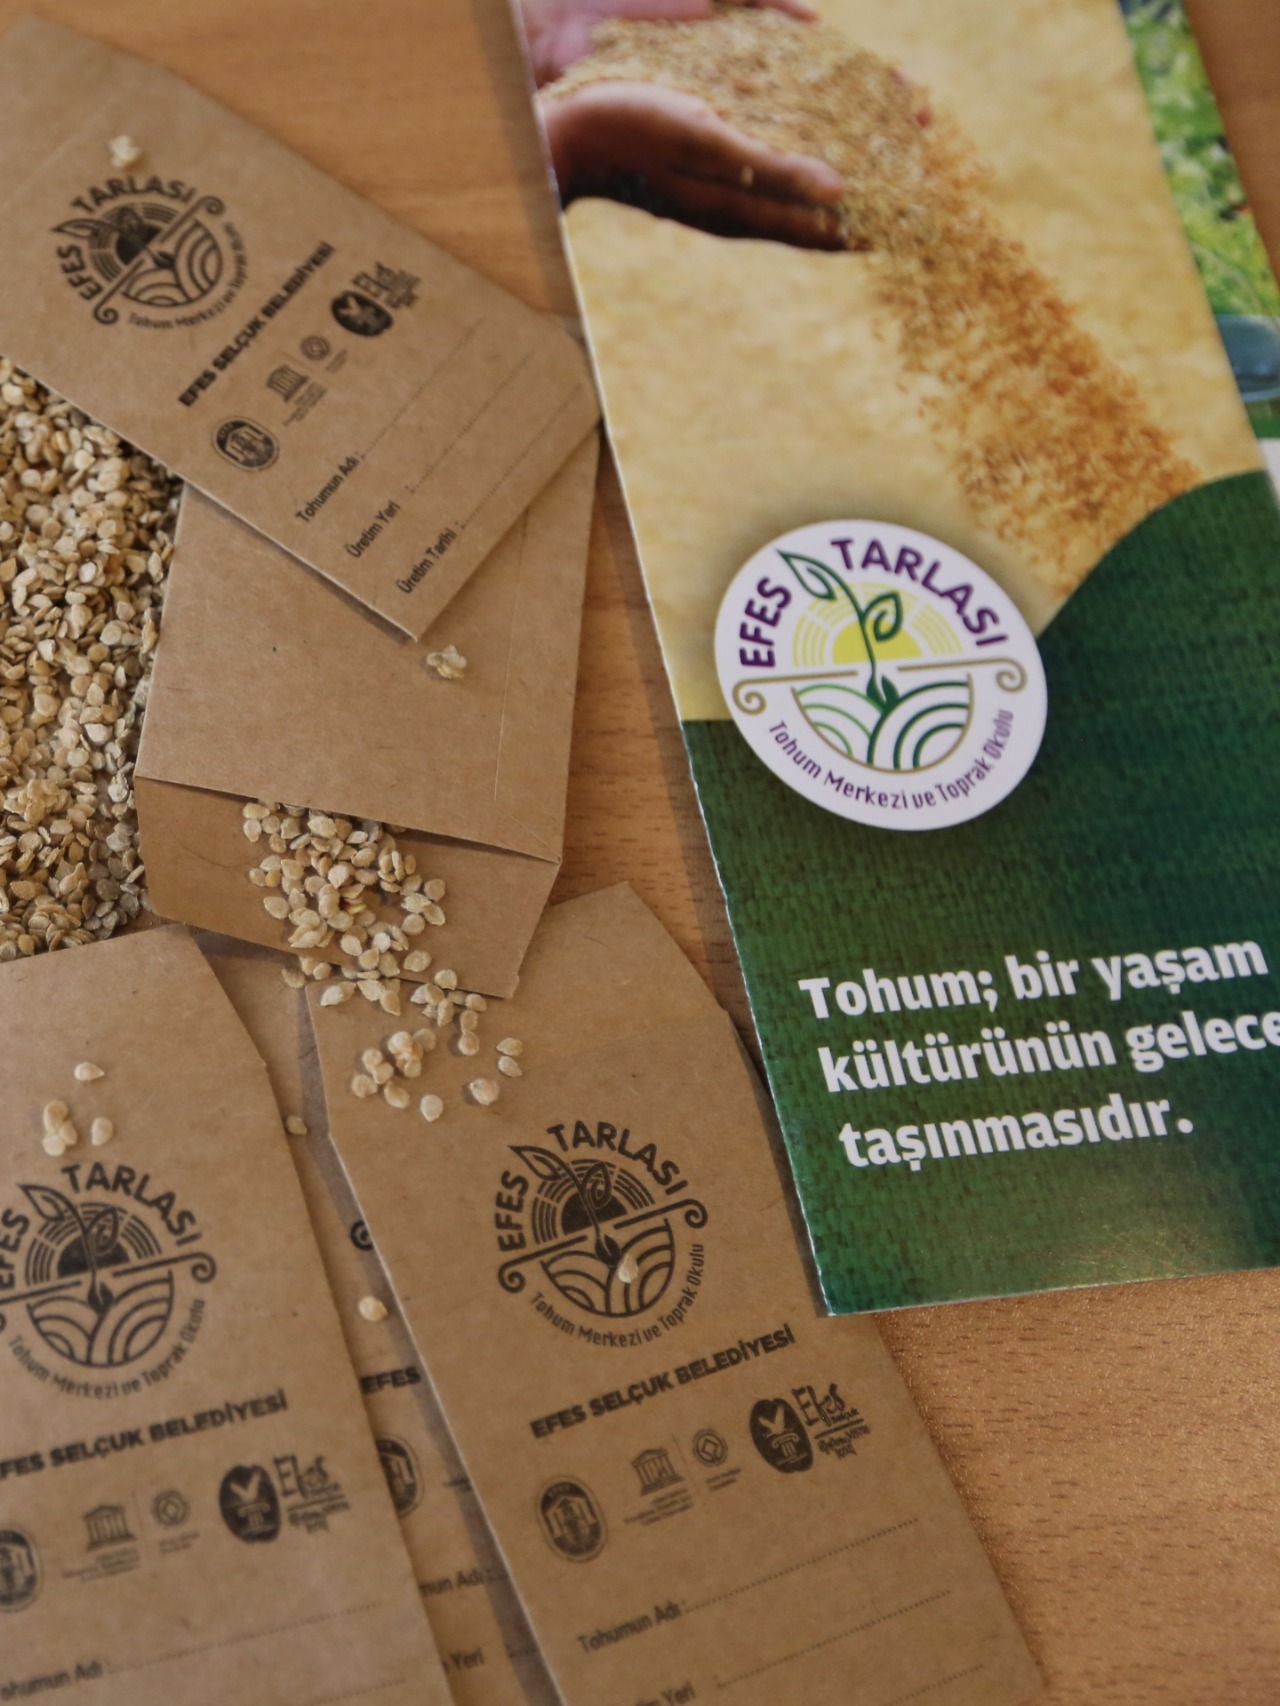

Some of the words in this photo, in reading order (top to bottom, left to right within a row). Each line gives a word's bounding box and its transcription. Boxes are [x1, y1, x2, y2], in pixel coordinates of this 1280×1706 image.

[72, 175, 197, 213] TARLASI
[57, 244, 104, 301] EFES
[178, 369, 217, 408] EFES
[212, 316, 267, 372] SELÇUK
[295, 473, 344, 523] Tohumun
[344, 522, 383, 559] Üretim
[375, 499, 401, 524] Yeri
[395, 558, 434, 595] Üretim
[425, 527, 457, 559] Tarihi
[739, 577, 792, 668] EFES
[830, 538, 1009, 647] TARLASI
[769, 720, 822, 779] Tohum
[824, 770, 908, 809] Merkezi
[913, 790, 937, 810] ve
[935, 755, 995, 803] Toprak
[983, 709, 1014, 761] Okulu
[798, 968, 999, 1013] Tohum;
[1004, 950, 1079, 1000] bir
[1092, 940, 1269, 1001] yaşam
[818, 1020, 1117, 1093] kültürünün
[838, 1093, 1194, 1171] taşınmasıdır.
[61, 1162, 202, 1246] TARLASI
[495, 1170, 529, 1251] EFES
[547, 1120, 689, 1195] TARLASI
[531, 1291, 575, 1334] Tohum
[578, 1324, 643, 1348] Merkezi
[645, 1323, 663, 1341] ve
[659, 1287, 698, 1332] Toprak
[686, 1244, 705, 1287] Okulu
[359, 1366, 421, 1395] EFES
[530, 1405, 587, 1439] EFES
[588, 1372, 675, 1417] SELÇUK
[674, 1323, 796, 1385] BELEDİYESİ
[50, 1428, 144, 1467] SELÇUK
[149, 1389, 289, 1443] BELEDİYESİ
[577, 1615, 653, 1653] Tohumun
